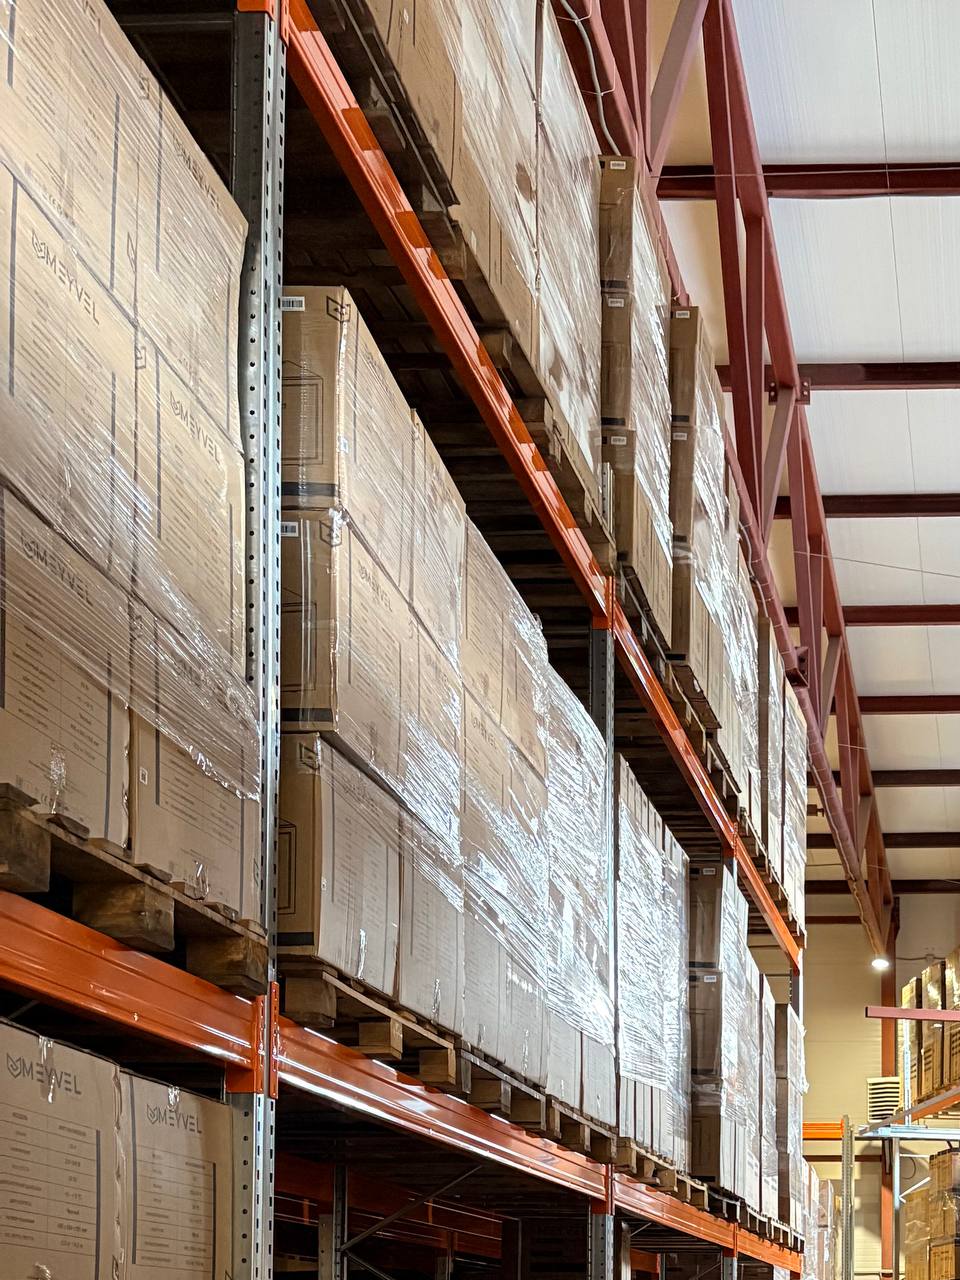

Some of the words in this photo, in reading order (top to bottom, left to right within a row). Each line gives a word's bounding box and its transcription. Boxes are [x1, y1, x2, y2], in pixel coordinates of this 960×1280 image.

[46, 248, 99, 325] MEYVEL
[181, 408, 220, 464] MEYVEL
[22, 1061, 82, 1095] MEYVEL
[158, 1107, 203, 1134] MEYVEL
